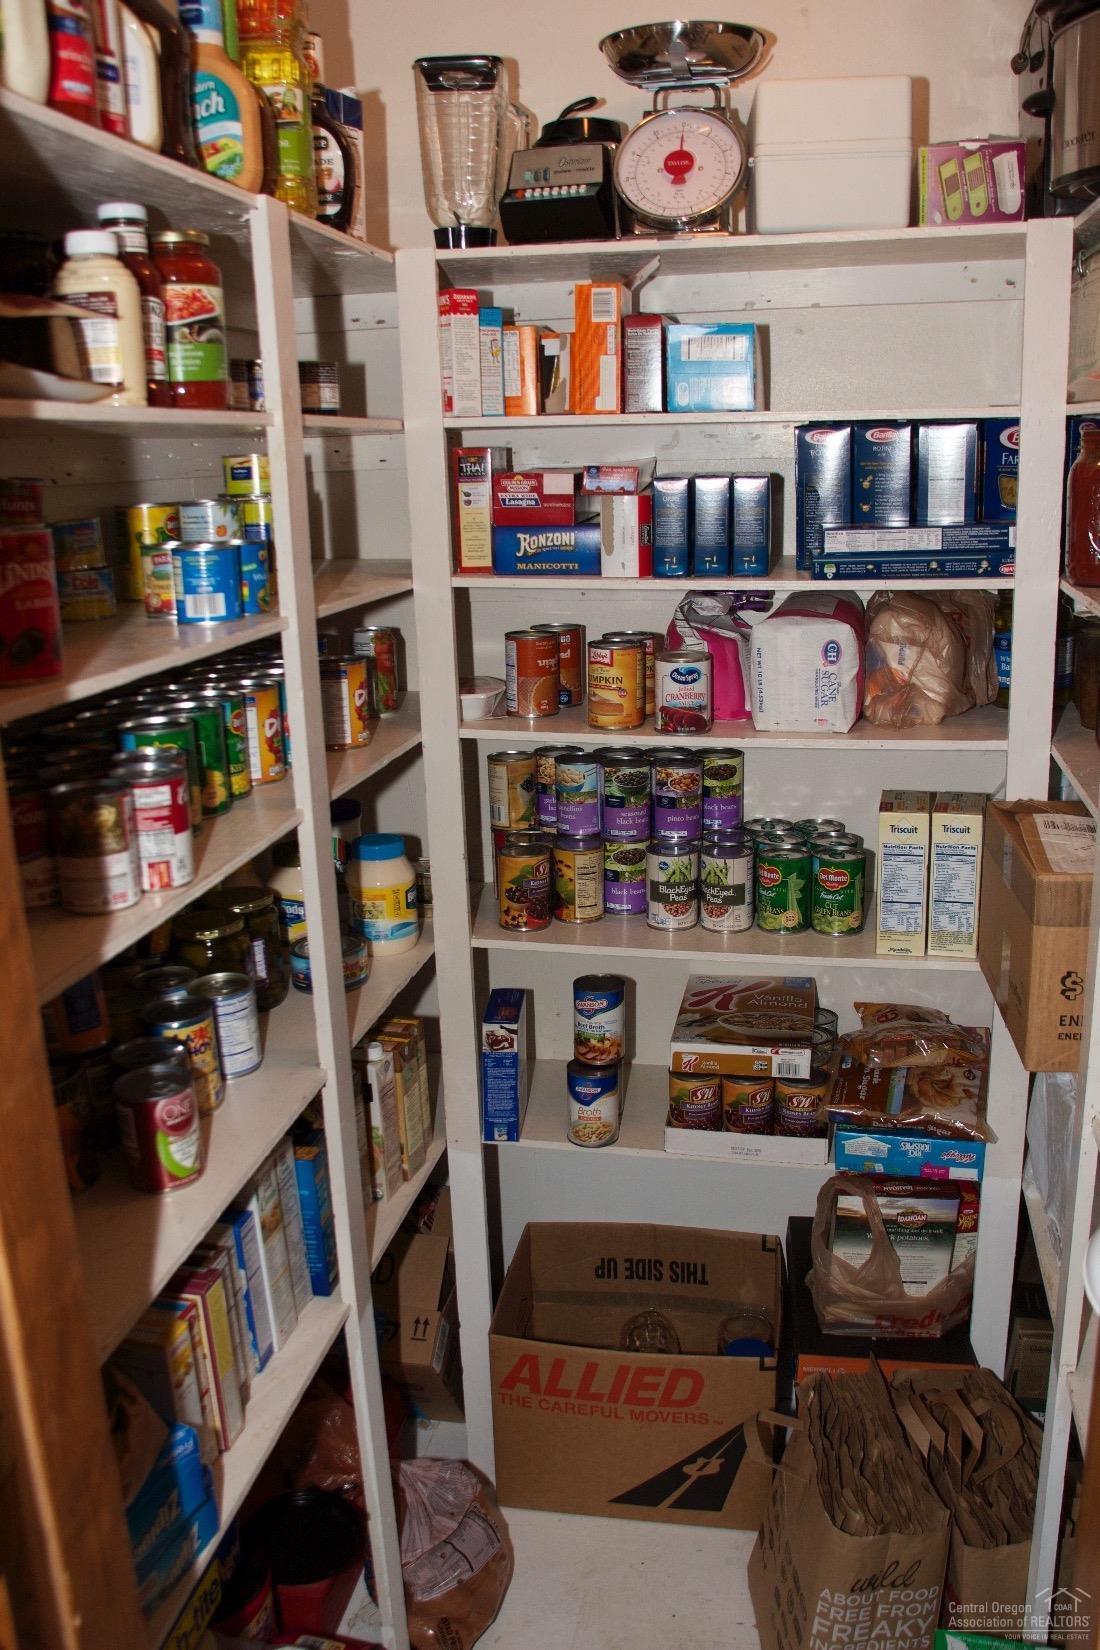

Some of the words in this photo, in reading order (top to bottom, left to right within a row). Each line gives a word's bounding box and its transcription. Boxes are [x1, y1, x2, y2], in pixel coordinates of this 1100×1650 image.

[505, 498, 536, 507] Lasagna
[516, 532, 576, 557] RONZONI
[671, 672, 687, 682] Ocean
[686, 671, 700, 682] Spray
[820, 670, 830, 707] SUGAR
[828, 672, 838, 702] CANE
[665, 692, 706, 703] CRANBERRY
[616, 817, 633, 825] black
[667, 815, 685, 823] pinto
[889, 824, 918, 834] Triscuit
[941, 824, 971, 834] Triscuit
[828, 873, 848, 882] Monte
[611, 887, 627, 896] black
[669, 893, 688, 902] Peas
[745, 999, 809, 1009] Almond
[588, 1023, 606, 1031] Broth
[577, 1106, 602, 1116] Broth
[897, 1214, 928, 1224] IDAHOAN
[594, 1257, 618, 1280] UP
[624, 1257, 664, 1282] SIDE
[669, 1260, 709, 1286] THIS
[499, 1353, 705, 1410] ALLIED
[498, 1392, 535, 1410] THE
[538, 1397, 625, 1420] CAREFUL
[629, 1408, 710, 1425] MOVERS
[850, 1559, 922, 1593] wild
[820, 1588, 885, 1607] ABOUT
[889, 1585, 939, 1602] FOOD
[816, 1599, 872, 1622] FREE
[876, 1598, 937, 1618] FROM
[811, 1614, 934, 1643] FREAKY
